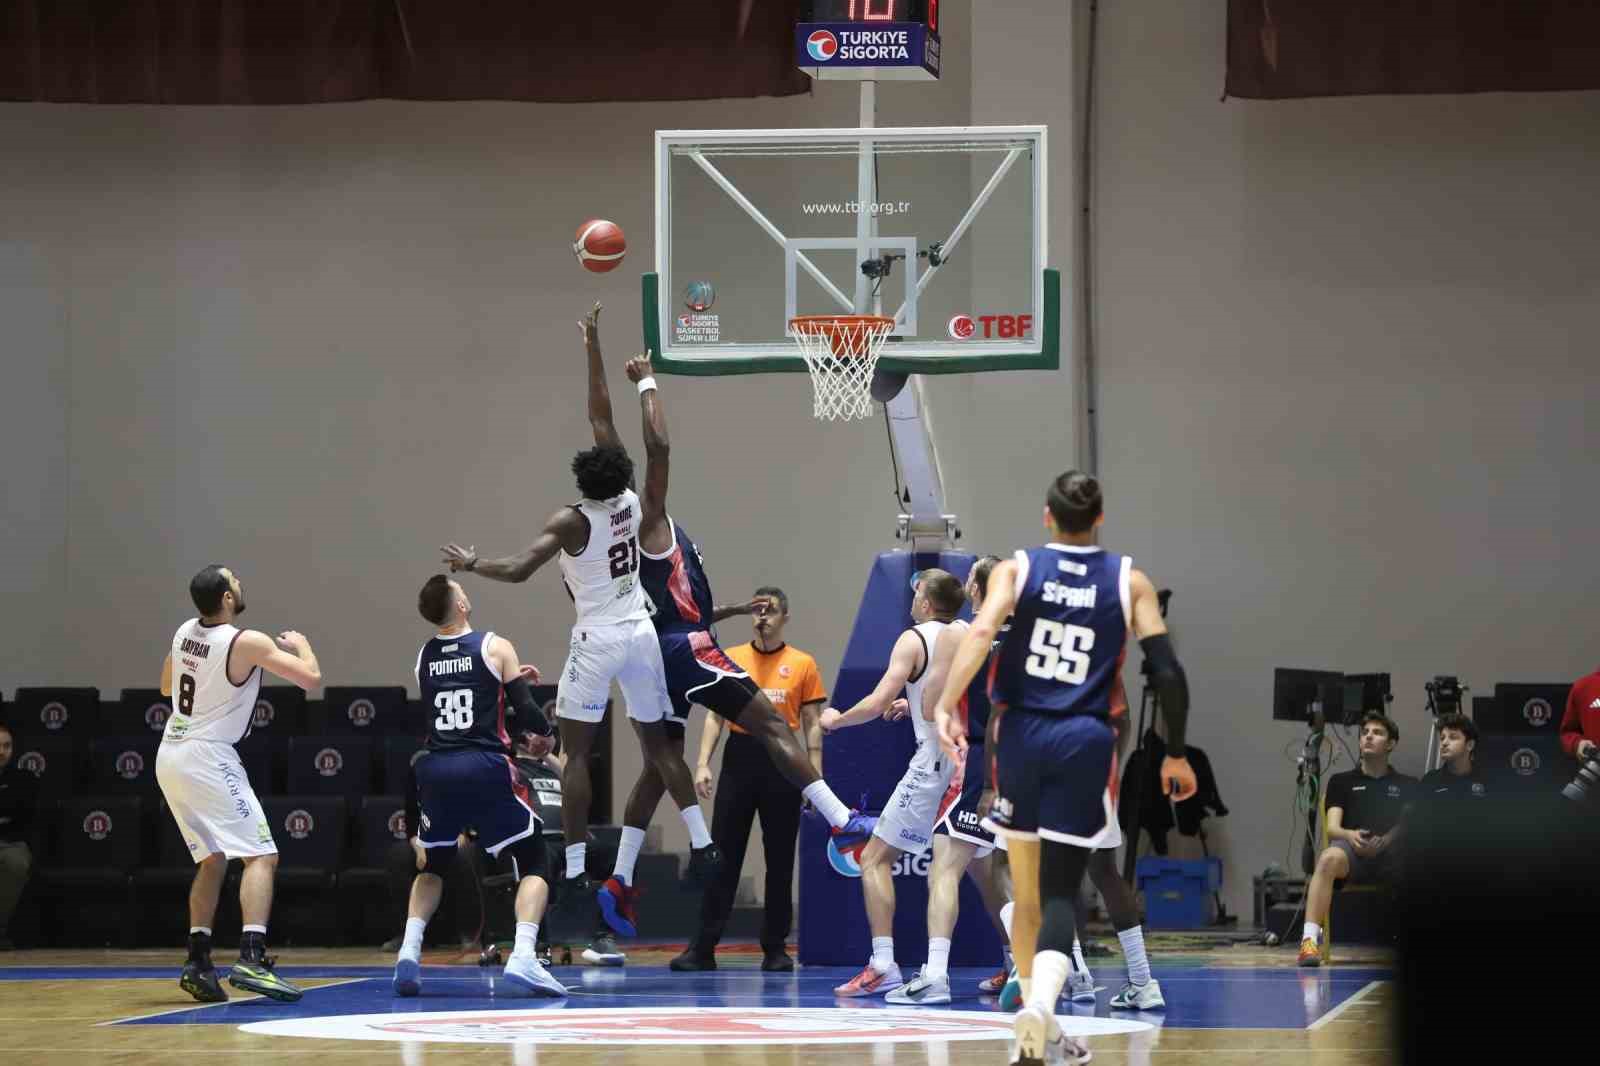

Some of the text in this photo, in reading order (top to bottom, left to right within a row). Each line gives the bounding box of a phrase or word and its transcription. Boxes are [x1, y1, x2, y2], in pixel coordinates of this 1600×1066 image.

[802, 201, 911, 215] www.tbf.org.tr
[978, 315, 1032, 338] TBF
[608, 536, 638, 579] 21
[1025, 617, 1096, 685] 55
[179, 673, 196, 717] 8
[434, 688, 474, 730] 38
